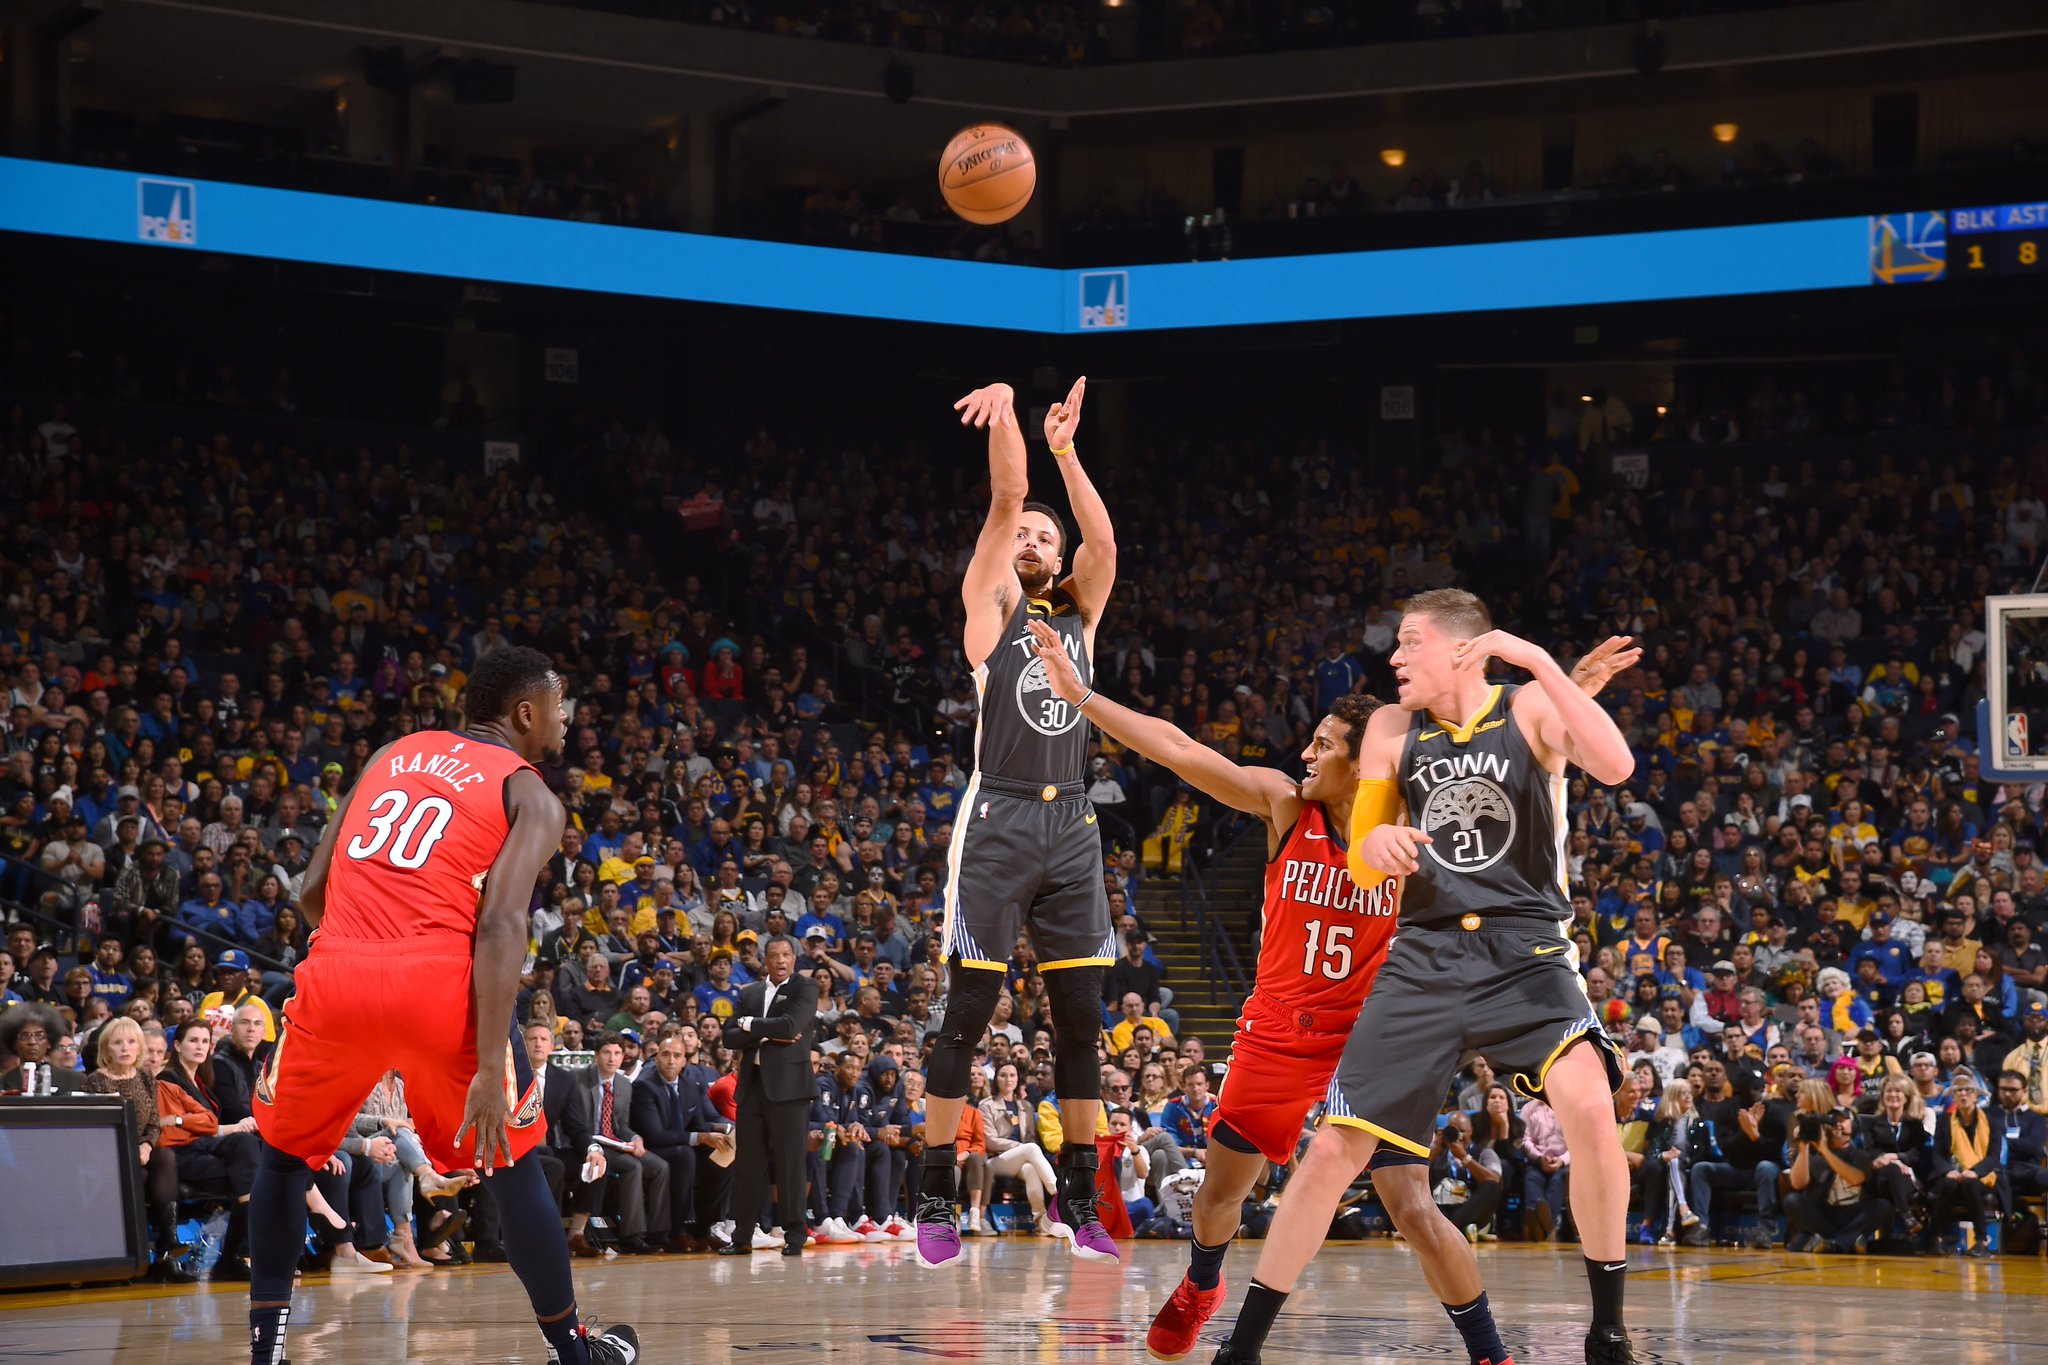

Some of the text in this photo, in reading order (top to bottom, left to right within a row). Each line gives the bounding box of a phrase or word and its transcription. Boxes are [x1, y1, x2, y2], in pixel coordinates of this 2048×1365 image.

[140, 215, 195, 244] PG&E
[1955, 204, 2048, 230] BLK AST
[1967, 241, 2038, 270] 1 8
[1082, 304, 1128, 328] PG&E
[548, 363, 576, 379] 106
[1040, 699, 1067, 728] 30
[390, 752, 485, 793] RANDLE
[1408, 751, 1510, 793] TOWN
[347, 789, 454, 869] 30
[1453, 829, 1489, 863] 21
[1281, 860, 1397, 916] PELICANS
[1303, 919, 1354, 980] 15
